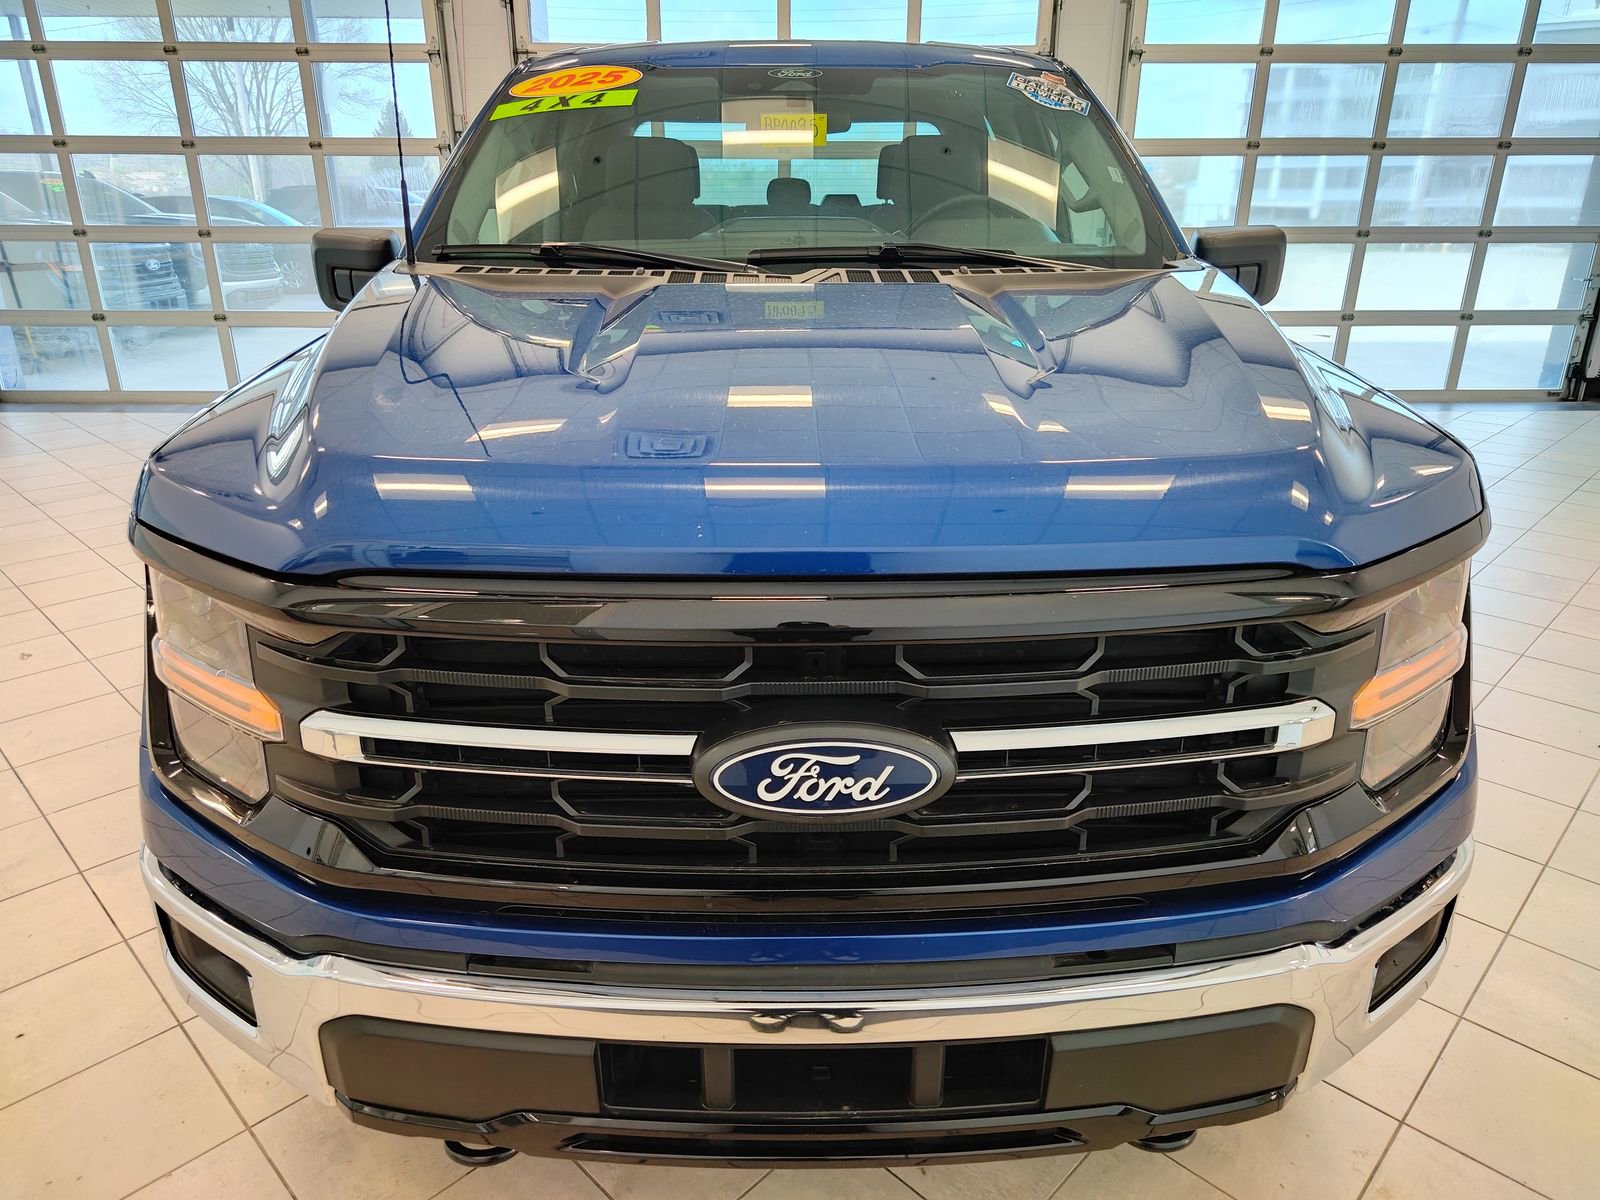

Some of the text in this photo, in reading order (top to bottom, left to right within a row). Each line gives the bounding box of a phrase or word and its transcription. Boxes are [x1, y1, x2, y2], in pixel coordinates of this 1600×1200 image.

[522, 70, 629, 94] 2025
[777, 68, 812, 78] Ford
[756, 753, 895, 802] Ford
